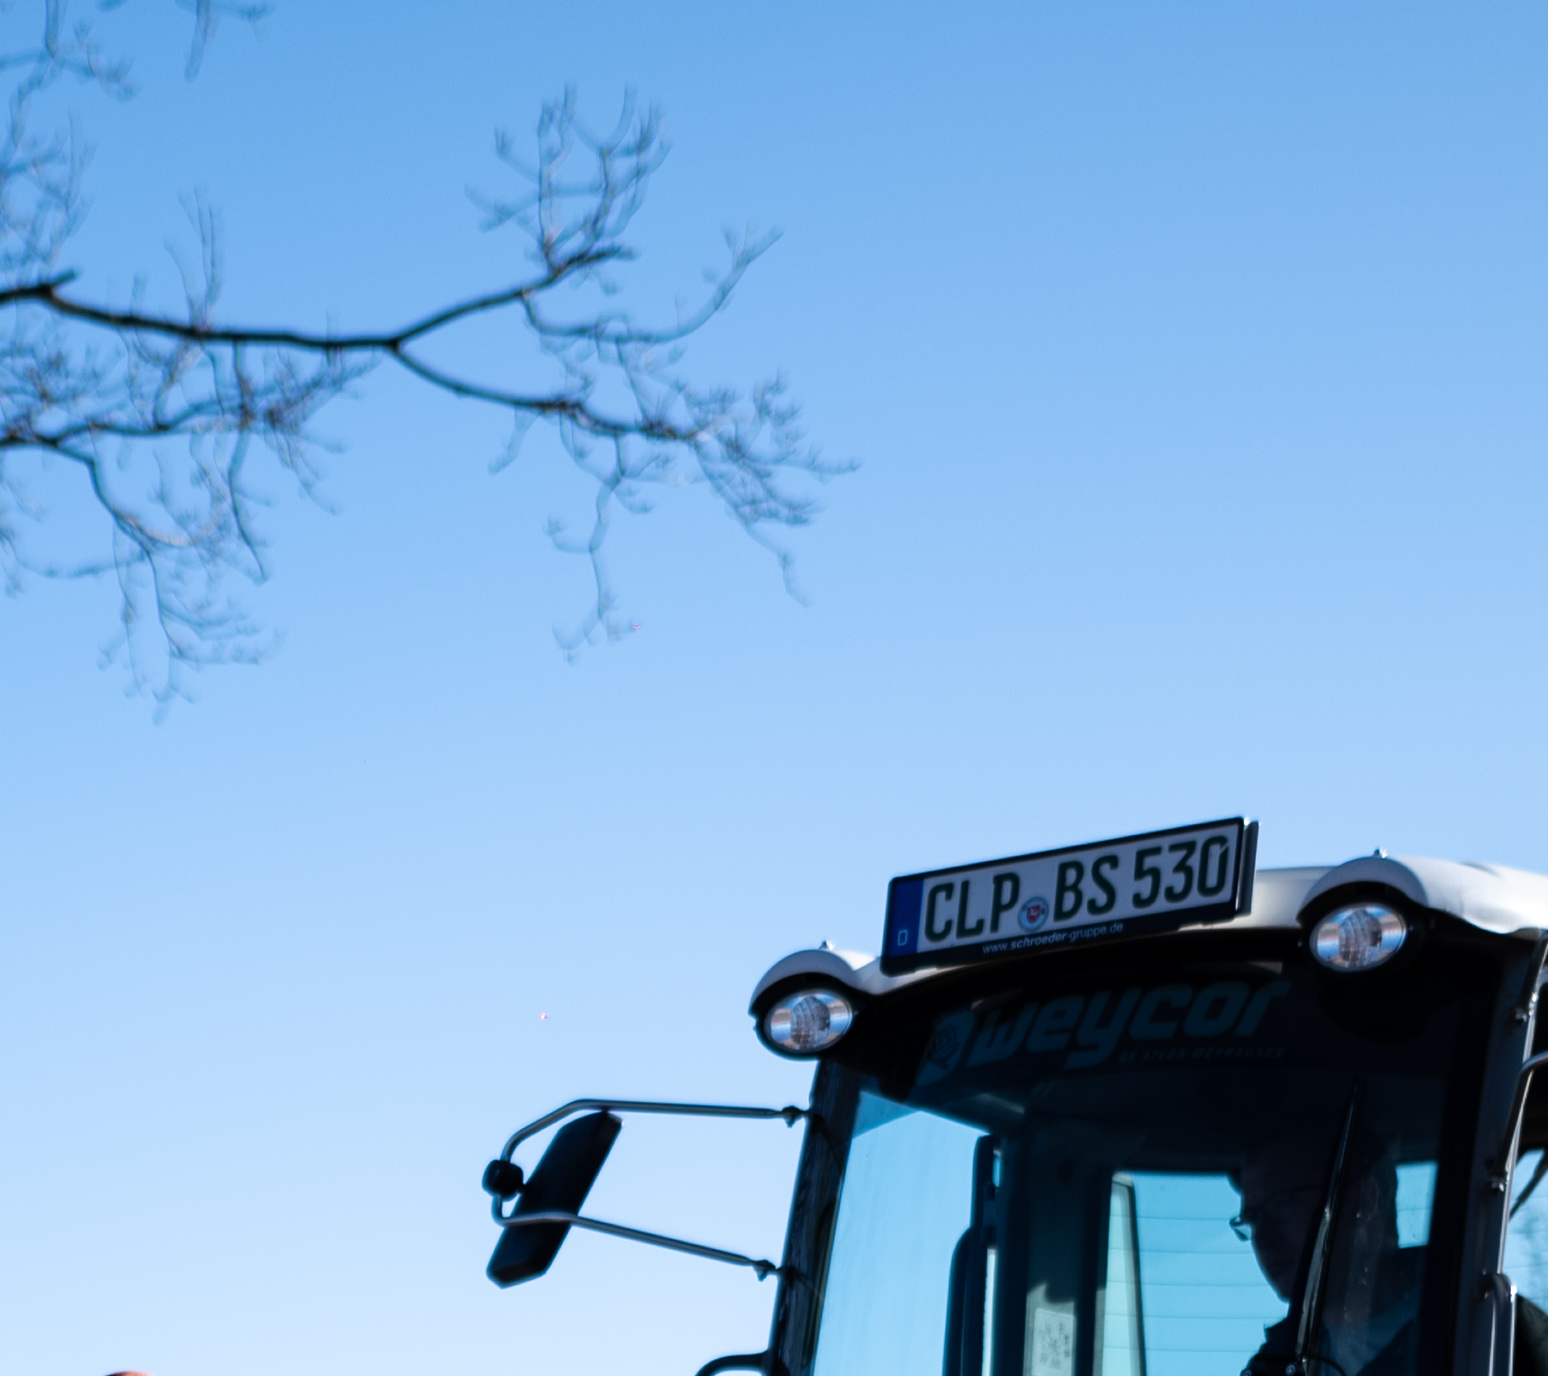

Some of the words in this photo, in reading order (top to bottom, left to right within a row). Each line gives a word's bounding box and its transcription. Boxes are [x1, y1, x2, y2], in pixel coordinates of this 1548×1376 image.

[924, 872, 1020, 942] CLP
[1053, 854, 1119, 922] BS
[1132, 835, 1229, 908] 530
[982, 922, 1124, 955] www.schroeder-gruppe.de
[966, 981, 1294, 1069] weycor
